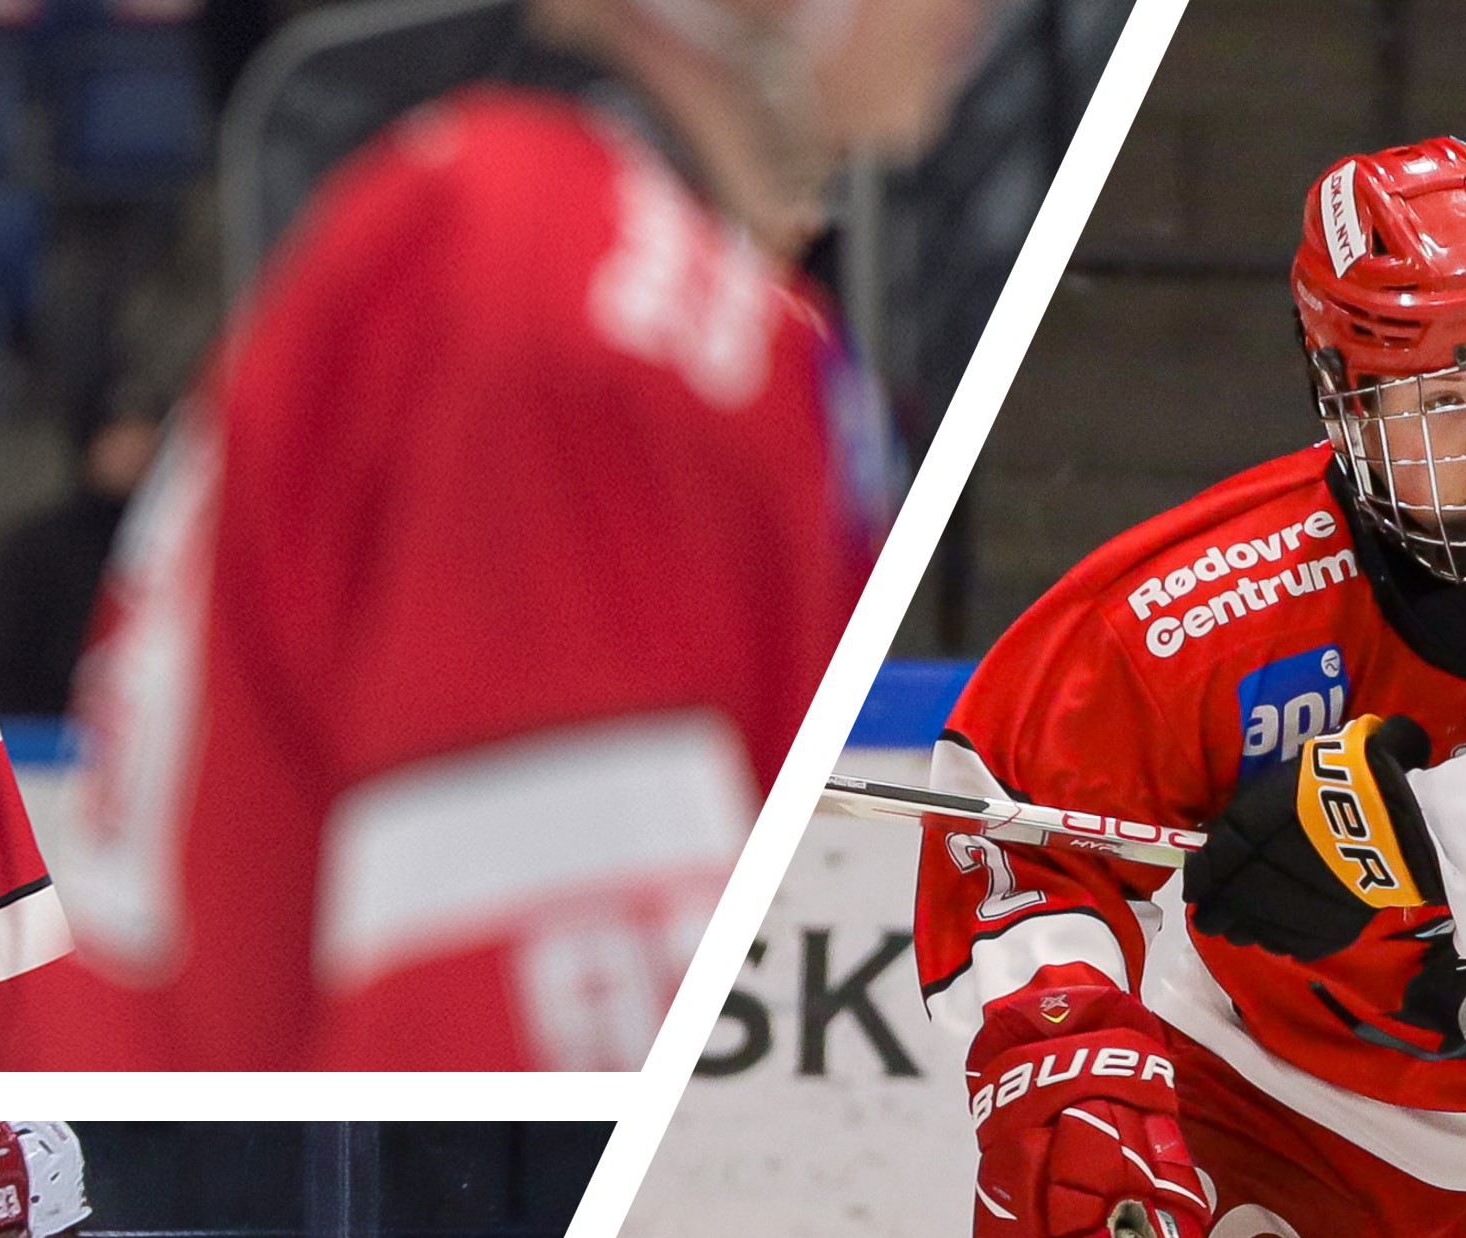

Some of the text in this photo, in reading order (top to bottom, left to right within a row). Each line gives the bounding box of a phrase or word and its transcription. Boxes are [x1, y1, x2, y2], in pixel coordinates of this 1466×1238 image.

[1336, 226, 1355, 263] NYT
[1128, 510, 1336, 621] Rødovre
[1145, 548, 1359, 658] Centrum
[946, 832, 1046, 922] 2
